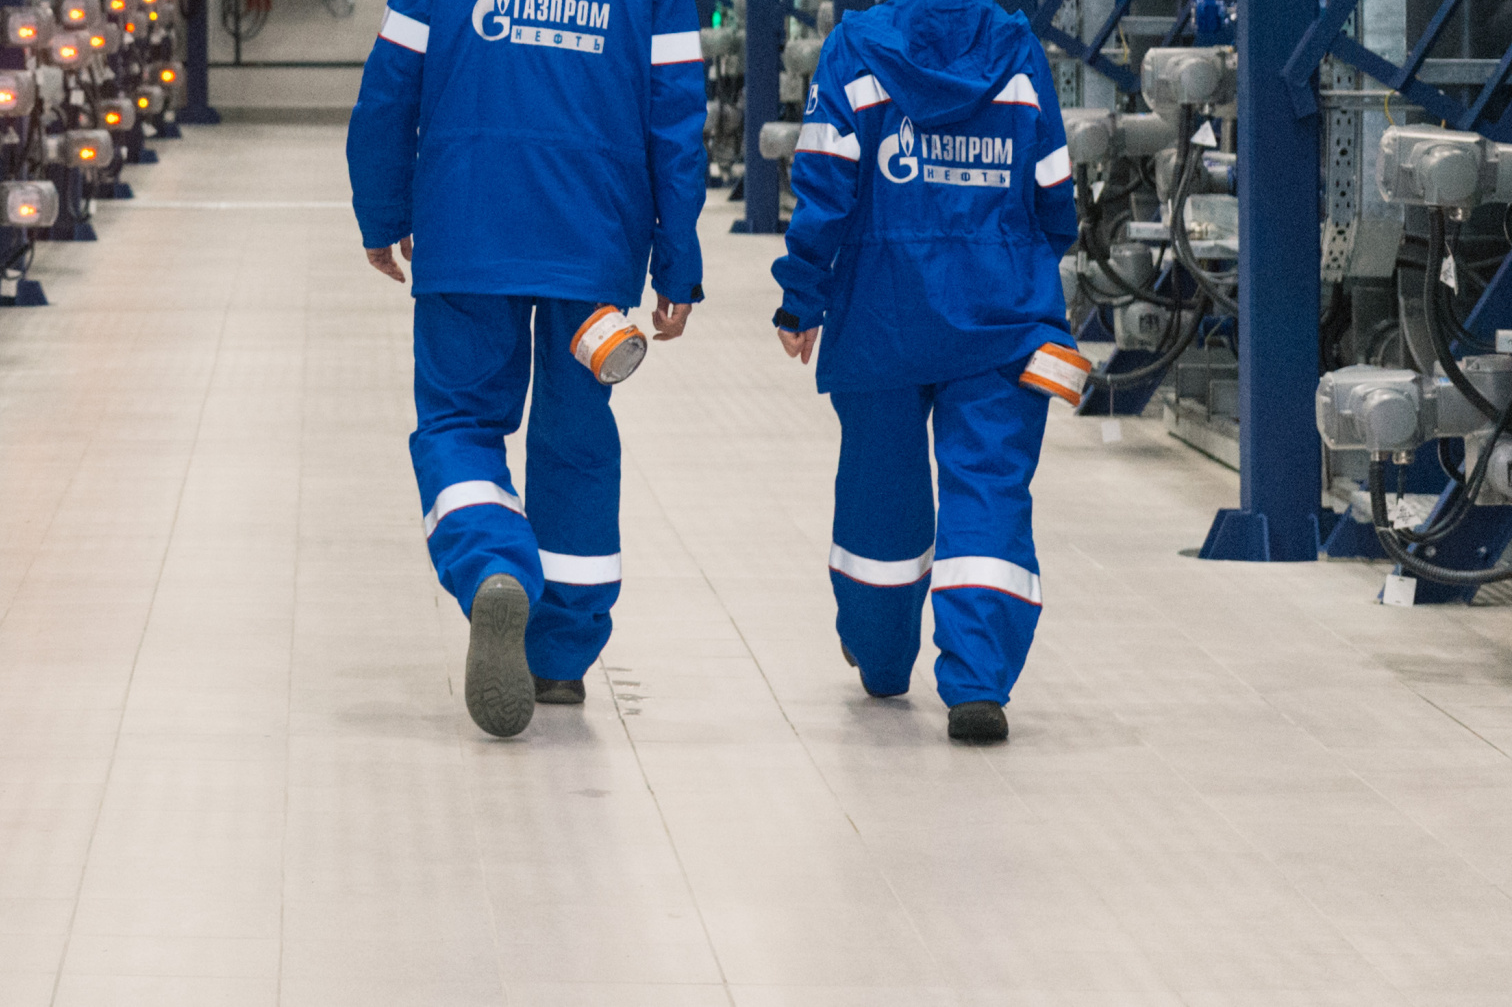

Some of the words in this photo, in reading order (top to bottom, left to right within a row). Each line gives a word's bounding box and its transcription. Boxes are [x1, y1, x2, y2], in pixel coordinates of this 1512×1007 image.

[515, 28, 601, 51] НЕФТЬ
[920, 133, 1013, 165] ГАЗПРОМ
[927, 168, 1006, 184] НЕФТЬ
